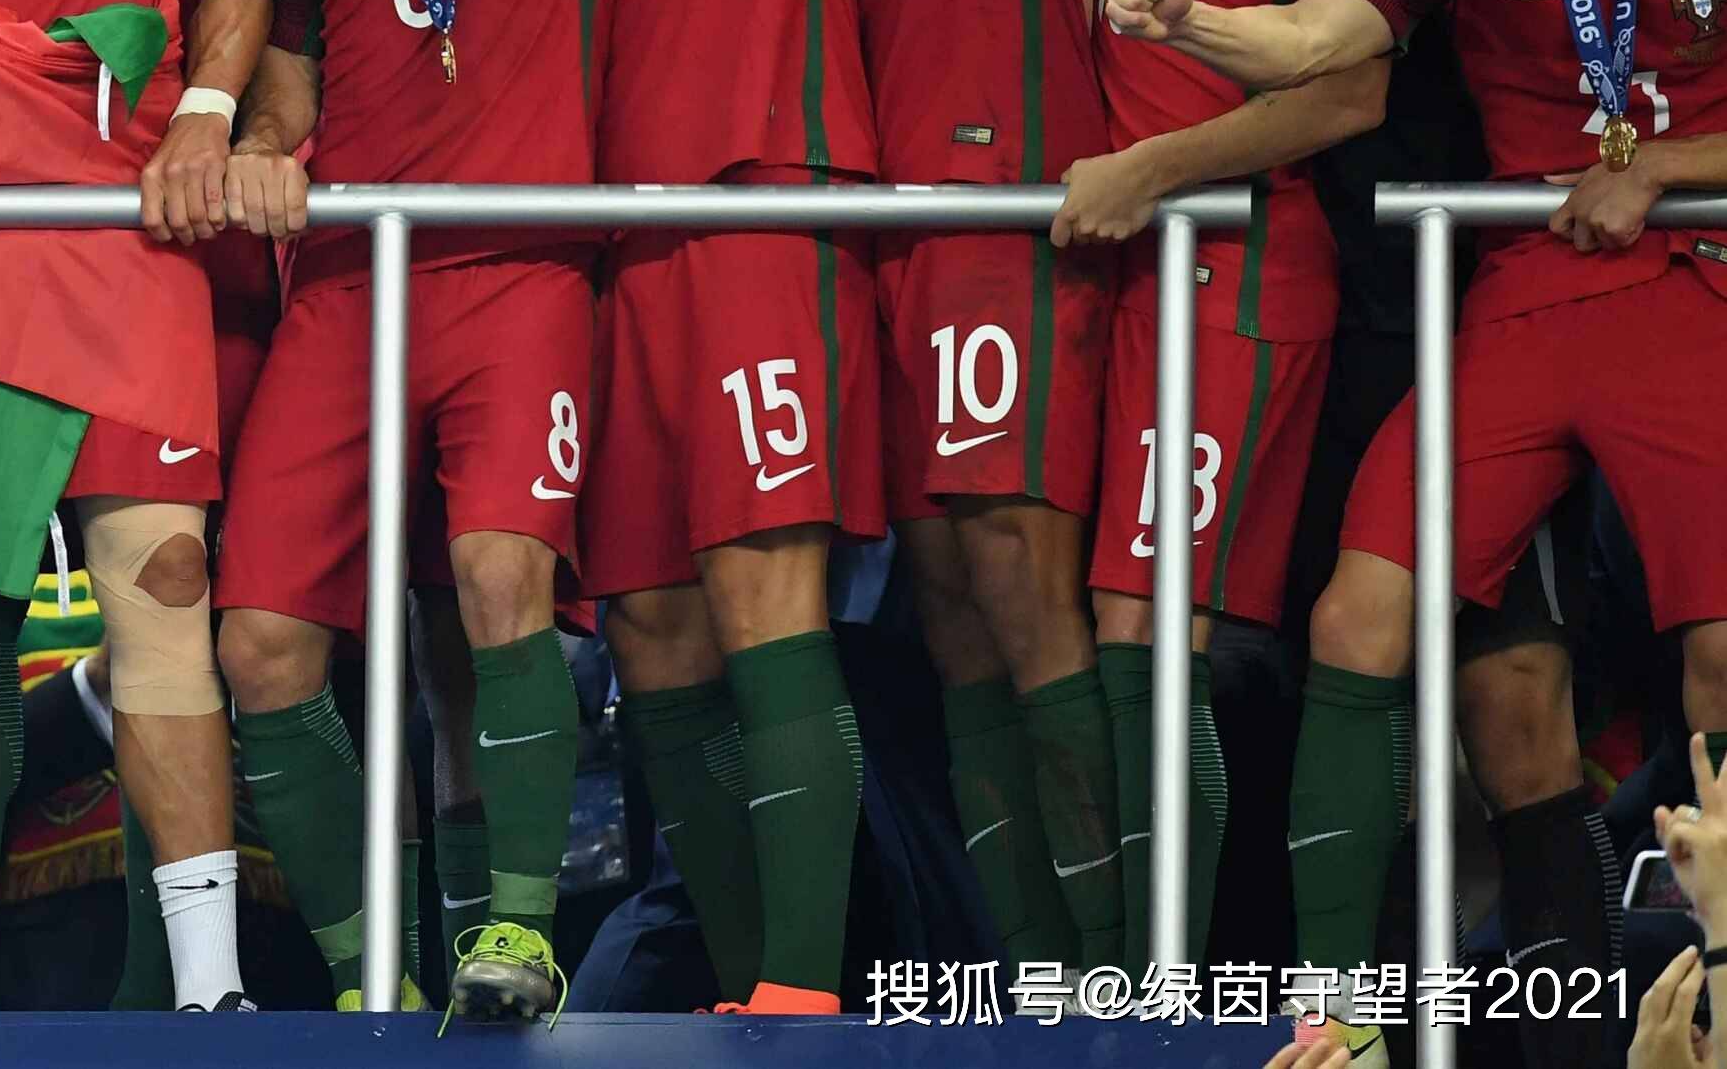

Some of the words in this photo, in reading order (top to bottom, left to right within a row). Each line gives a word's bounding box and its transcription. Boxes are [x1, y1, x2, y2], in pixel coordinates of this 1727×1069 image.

[721, 358, 809, 465] 15
[930, 324, 1019, 425] 10
[547, 391, 581, 483] 8
